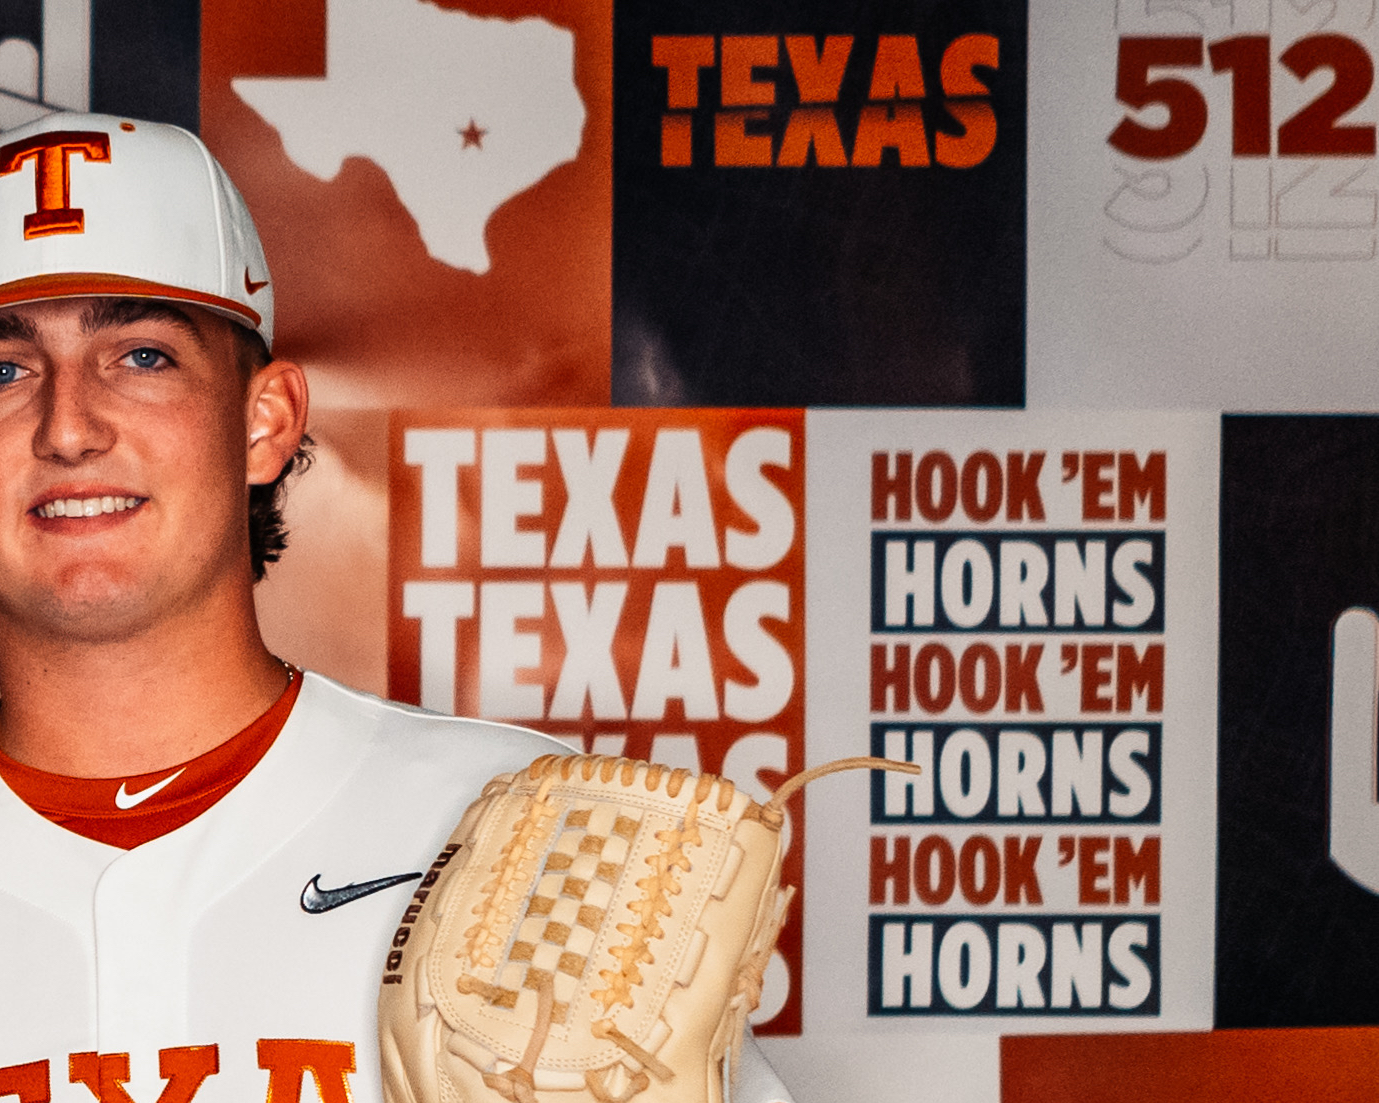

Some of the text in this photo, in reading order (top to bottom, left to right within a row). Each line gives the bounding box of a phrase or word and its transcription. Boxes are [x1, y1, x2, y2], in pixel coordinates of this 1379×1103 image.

[1107, 32, 1377, 161] 512
[403, 426, 796, 571] TEXAS
[870, 450, 1046, 524] HOOK
[884, 539, 1156, 628] HORNS
[402, 579, 795, 723] TEXAS
[869, 642, 1045, 715] HOOK
[884, 729, 1153, 818] HORNS
[383, 843, 463, 985] marucci
[869, 834, 1043, 907] HOOK
[881, 920, 1152, 1011] HORNS
